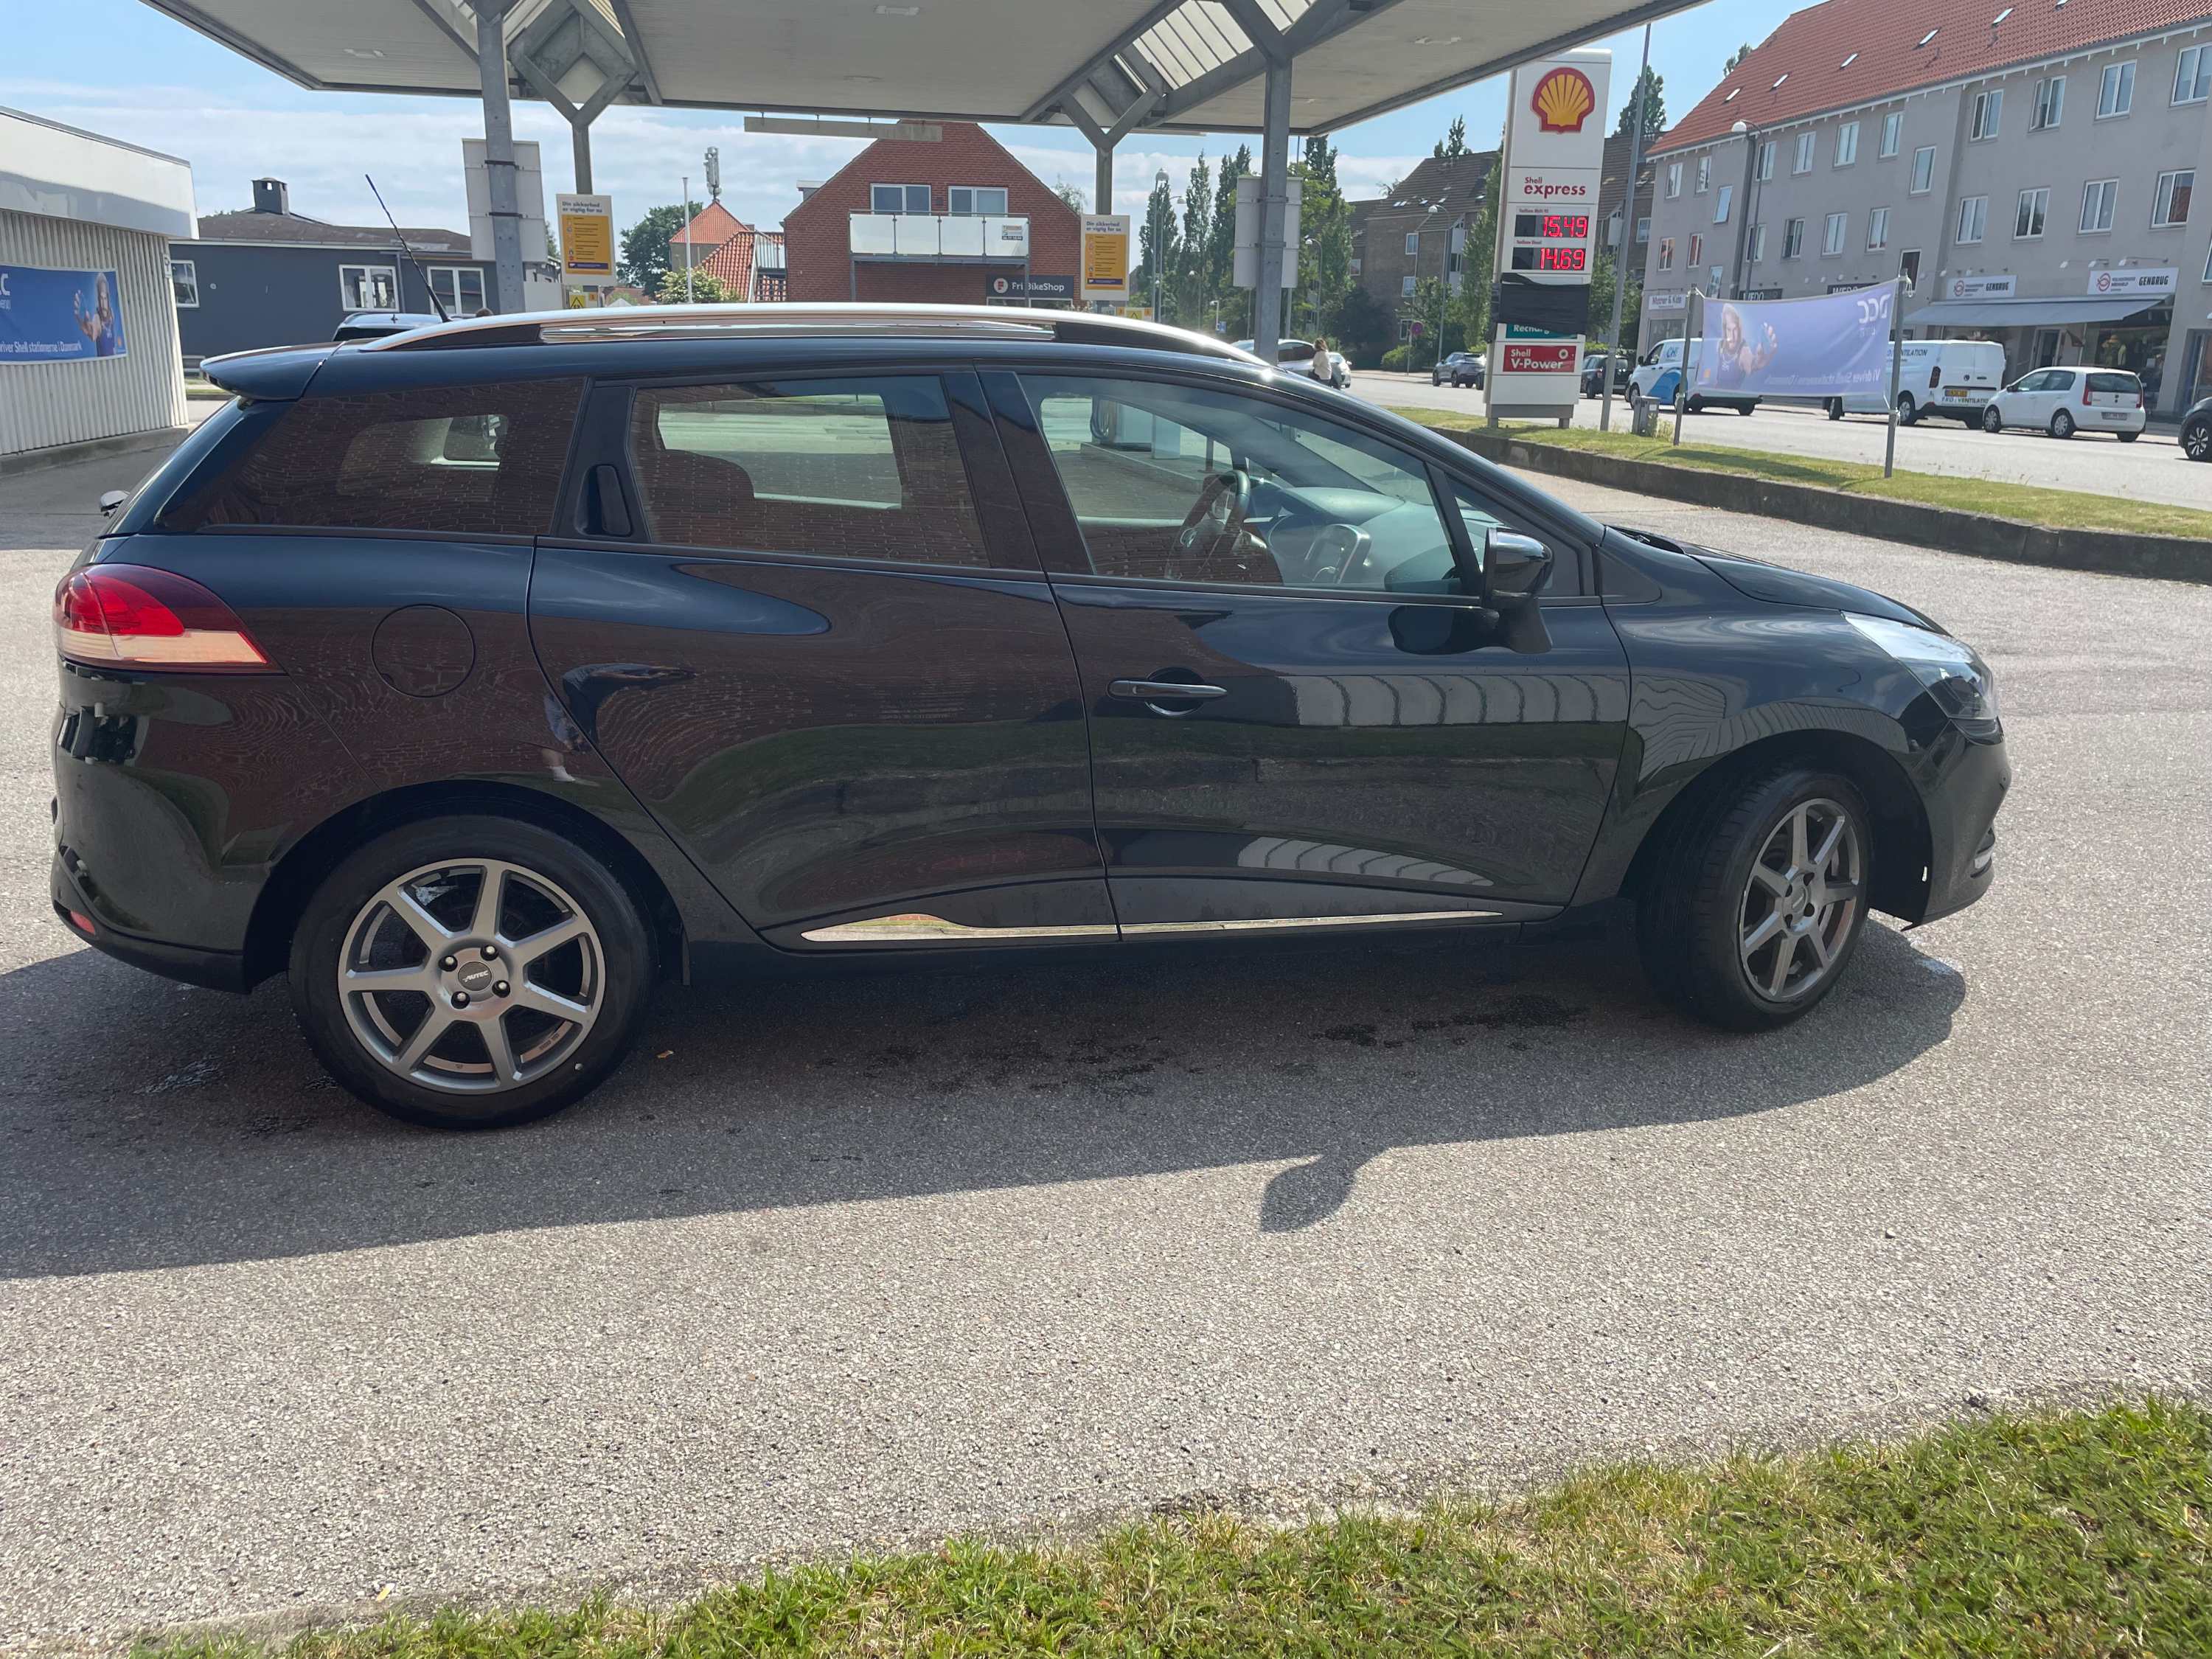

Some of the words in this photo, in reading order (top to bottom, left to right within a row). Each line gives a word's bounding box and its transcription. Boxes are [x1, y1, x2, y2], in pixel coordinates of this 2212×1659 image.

[1524, 184, 1586, 199] express
[1543, 215, 1587, 237] 15.49
[1540, 247, 1585, 270] 14.69
[2138, 276, 2169, 286] GENBRUG
[1986, 282, 2010, 292] GENBRUG
[0, 341, 14, 352] river
[14, 341, 29, 352] Shell
[1511, 348, 1531, 357] Shell
[1511, 358, 1563, 369] V-Power
[462, 970, 489, 983] AUTEC
